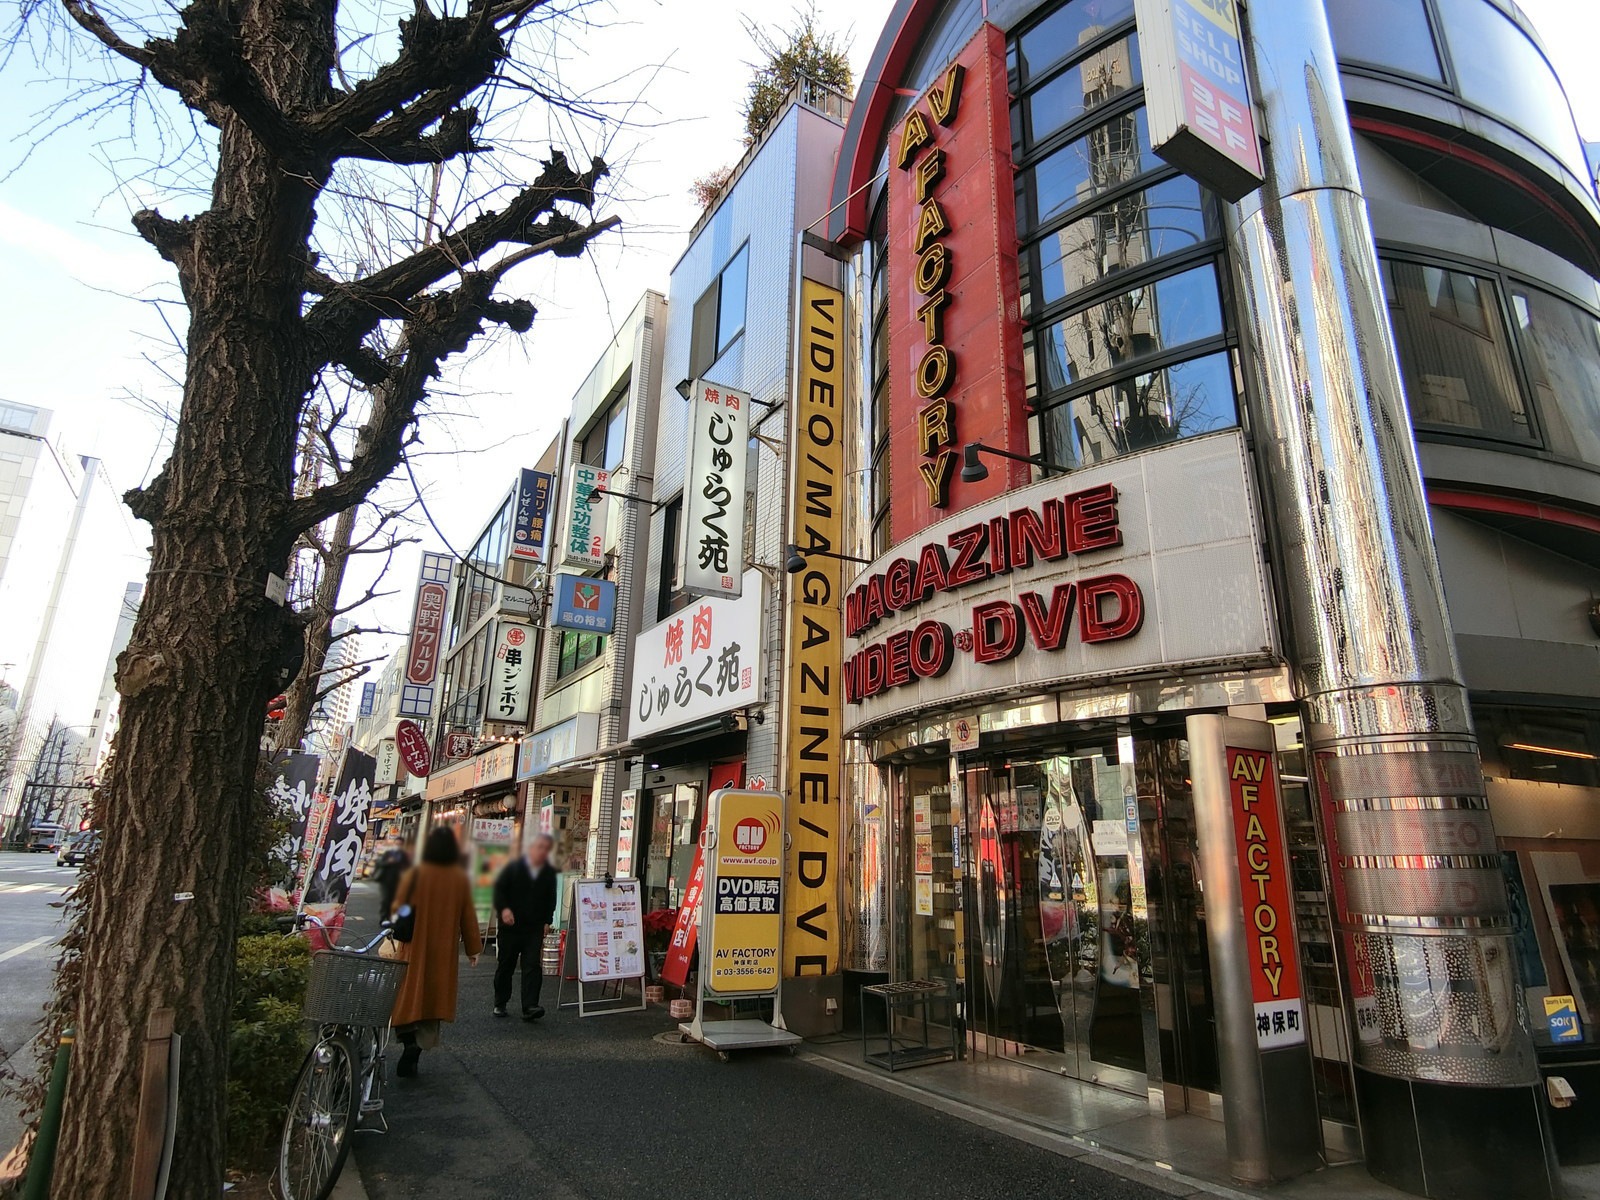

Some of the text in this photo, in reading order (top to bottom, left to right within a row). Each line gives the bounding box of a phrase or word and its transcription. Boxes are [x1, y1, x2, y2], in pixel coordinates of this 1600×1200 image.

[1175, 4, 1237, 64] SELL
[1178, 30, 1240, 85] SHOP
[898, 60, 967, 509] AV FACTORY
[703, 386, 741, 412] 焼肉
[697, 411, 737, 575] じゅらく苑
[591, 536, 602, 557] 2階
[845, 482, 1124, 639] MAGAZINE
[413, 591, 442, 677] 奥野カルタ
[664, 604, 713, 668] 焼肉
[843, 573, 1146, 705] VIDEO DVD
[499, 648, 522, 717] 串ジンボウ
[638, 642, 742, 723] じゅらく苑
[401, 727, 426, 772] レコード社
[320, 777, 372, 888] 焼肉
[722, 857, 777, 866] www.avf.co.jp
[718, 878, 779, 895] DVD販売
[720, 896, 775, 912] 高価買取
[1231, 754, 1283, 997] AV FACTORY
[715, 948, 777, 959] AV FACTORY
[1255, 1009, 1300, 1037] 神保町
